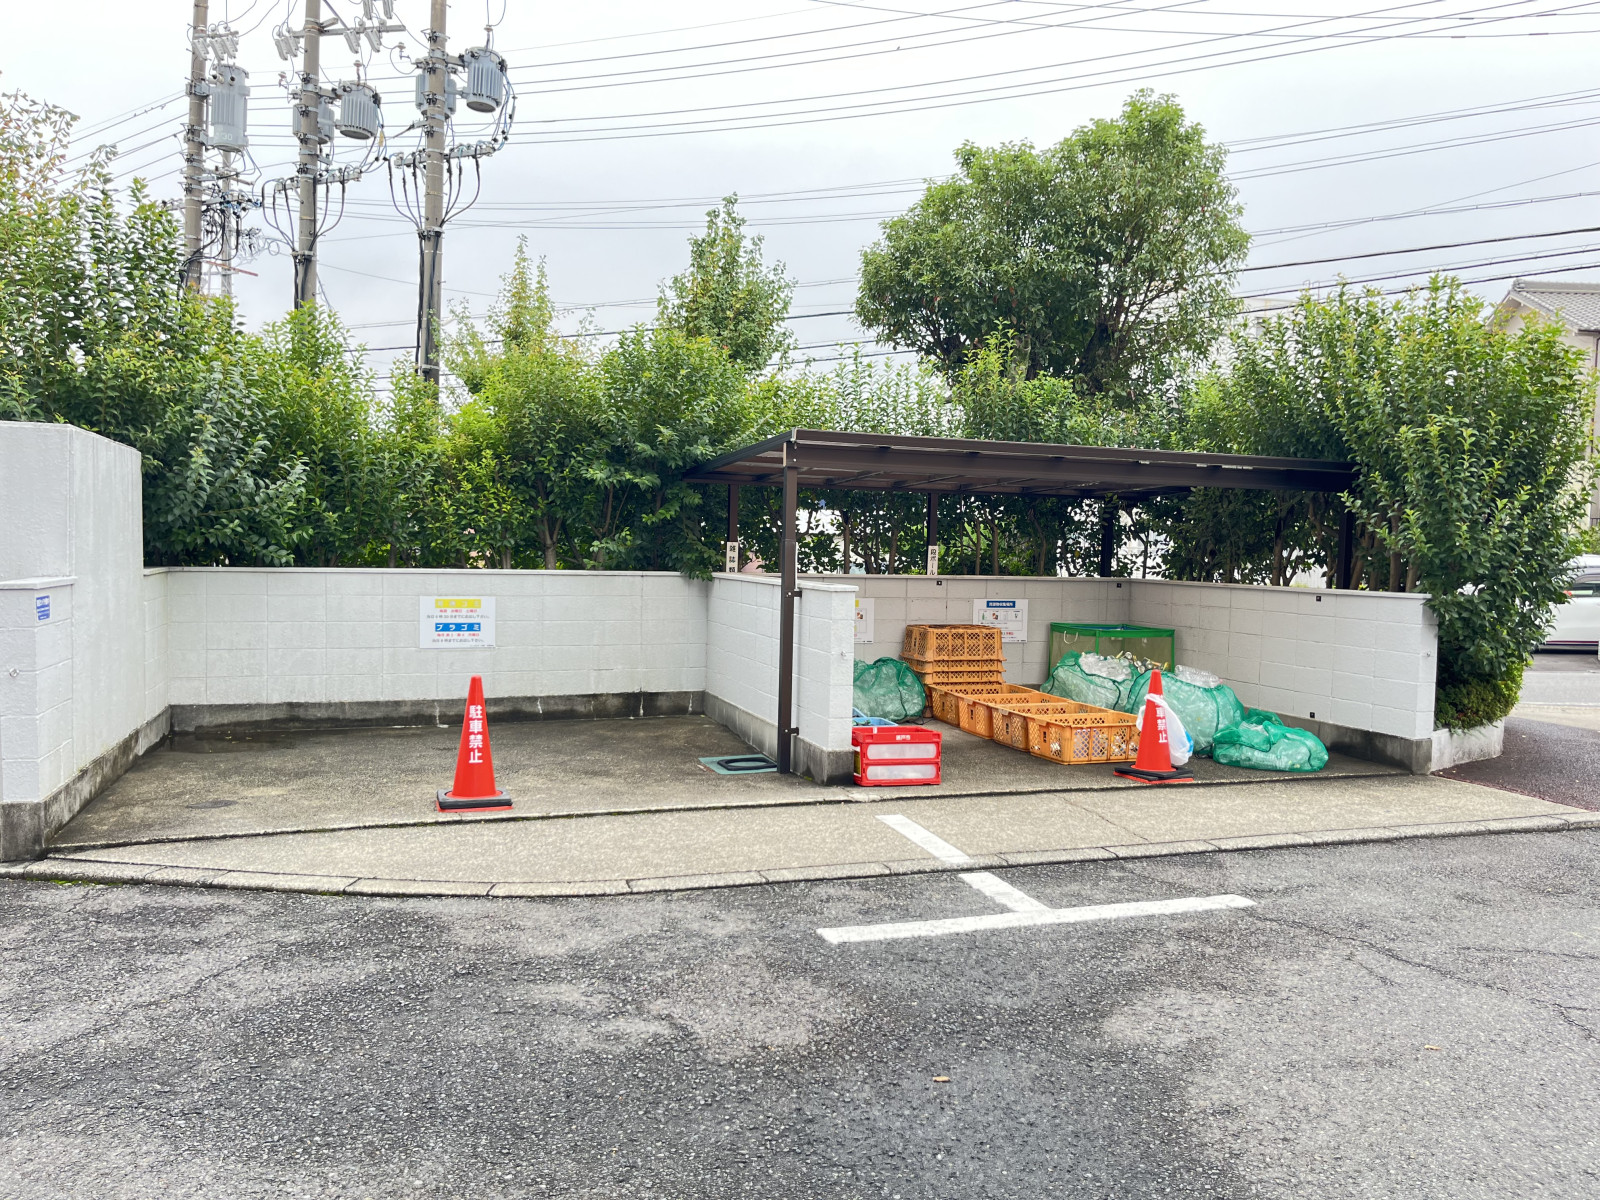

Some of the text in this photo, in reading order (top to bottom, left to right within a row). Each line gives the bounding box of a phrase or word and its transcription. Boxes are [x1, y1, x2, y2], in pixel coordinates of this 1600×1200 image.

[469, 704, 483, 763] 駐車禁止
[1154, 702, 1168, 743] 車禁止
